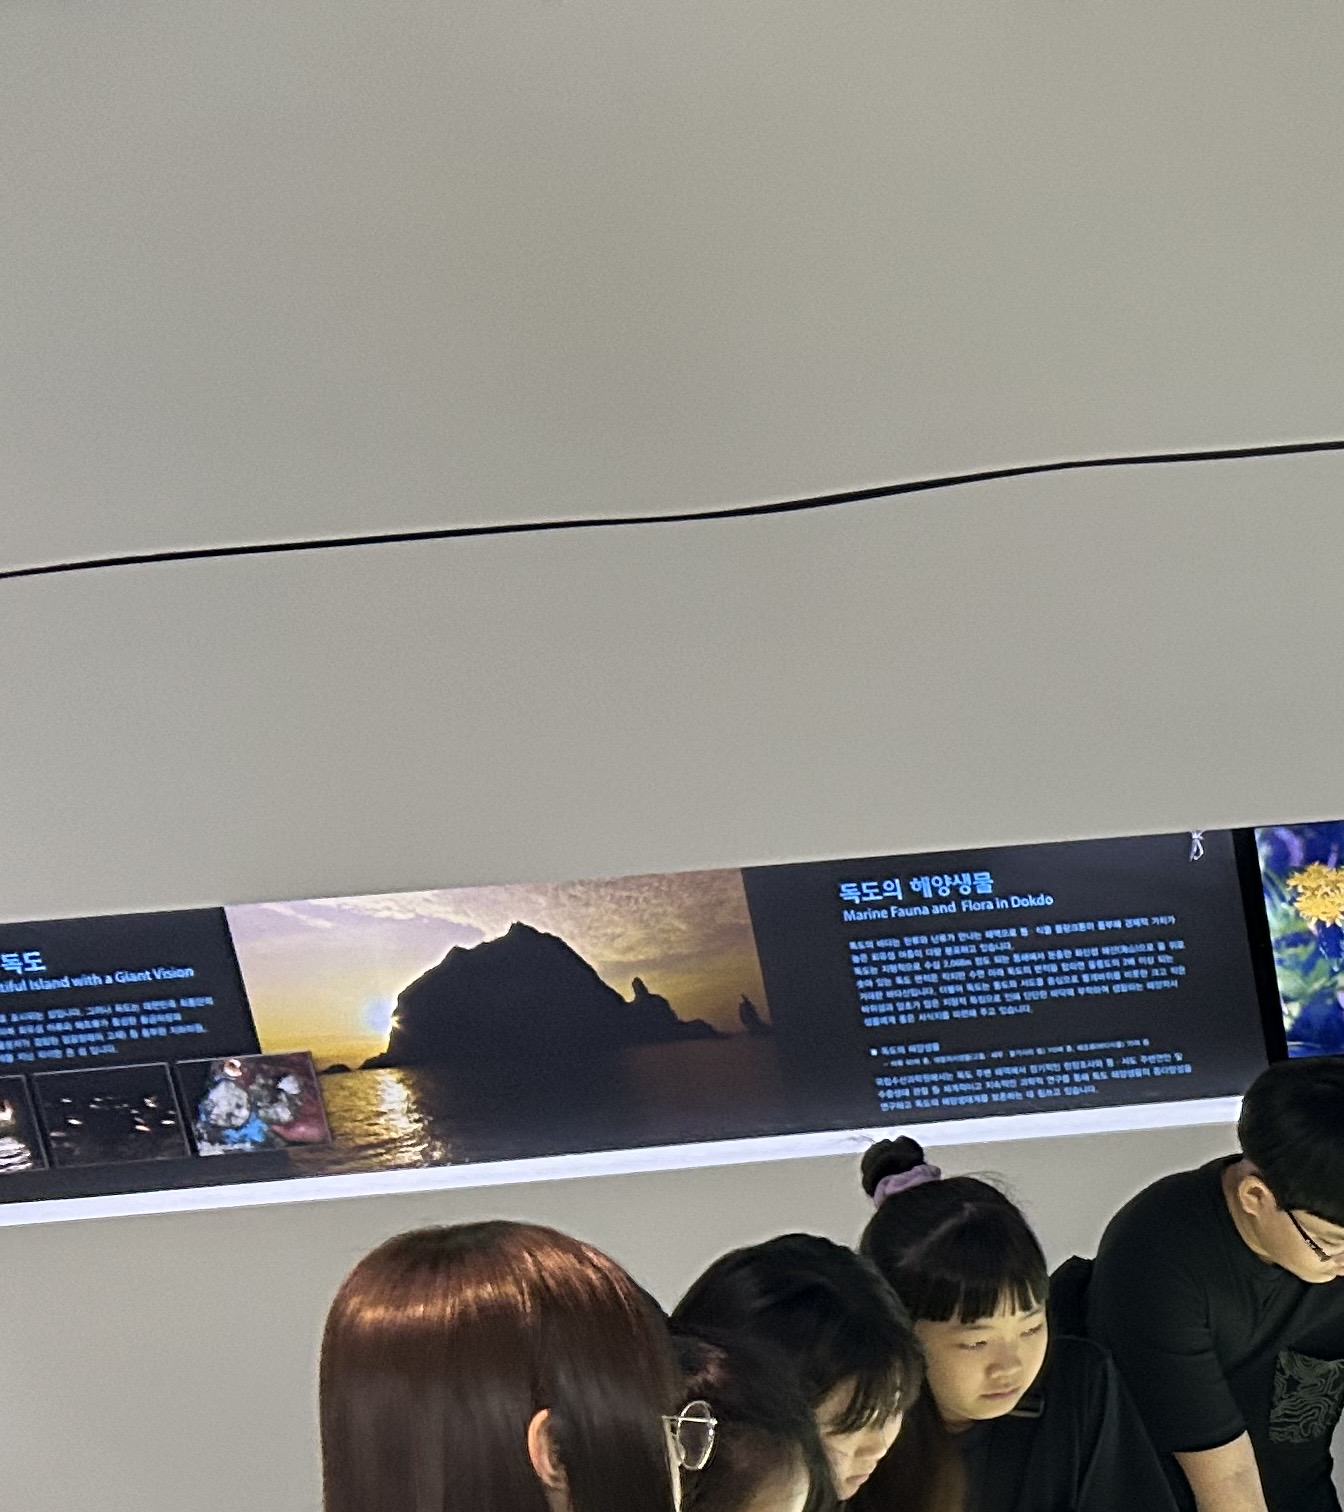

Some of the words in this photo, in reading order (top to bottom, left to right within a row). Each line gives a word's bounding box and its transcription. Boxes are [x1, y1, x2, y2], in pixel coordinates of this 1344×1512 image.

[839, 878, 903, 904] 독도의
[909, 871, 994, 898] 해양생물
[843, 907, 888, 922] Marine
[890, 904, 929, 918] Fauna
[931, 902, 956, 915] and
[961, 899, 994, 912] Flora
[996, 897, 1009, 909] in
[1011, 894, 1054, 909] Dokdo
[0, 951, 47, 975] 독도
[29, 976, 70, 990] Island
[71, 973, 102, 987] with
[104, 975, 113, 984] a
[115, 970, 151, 983] Giant
[152, 967, 194, 980] Vision
